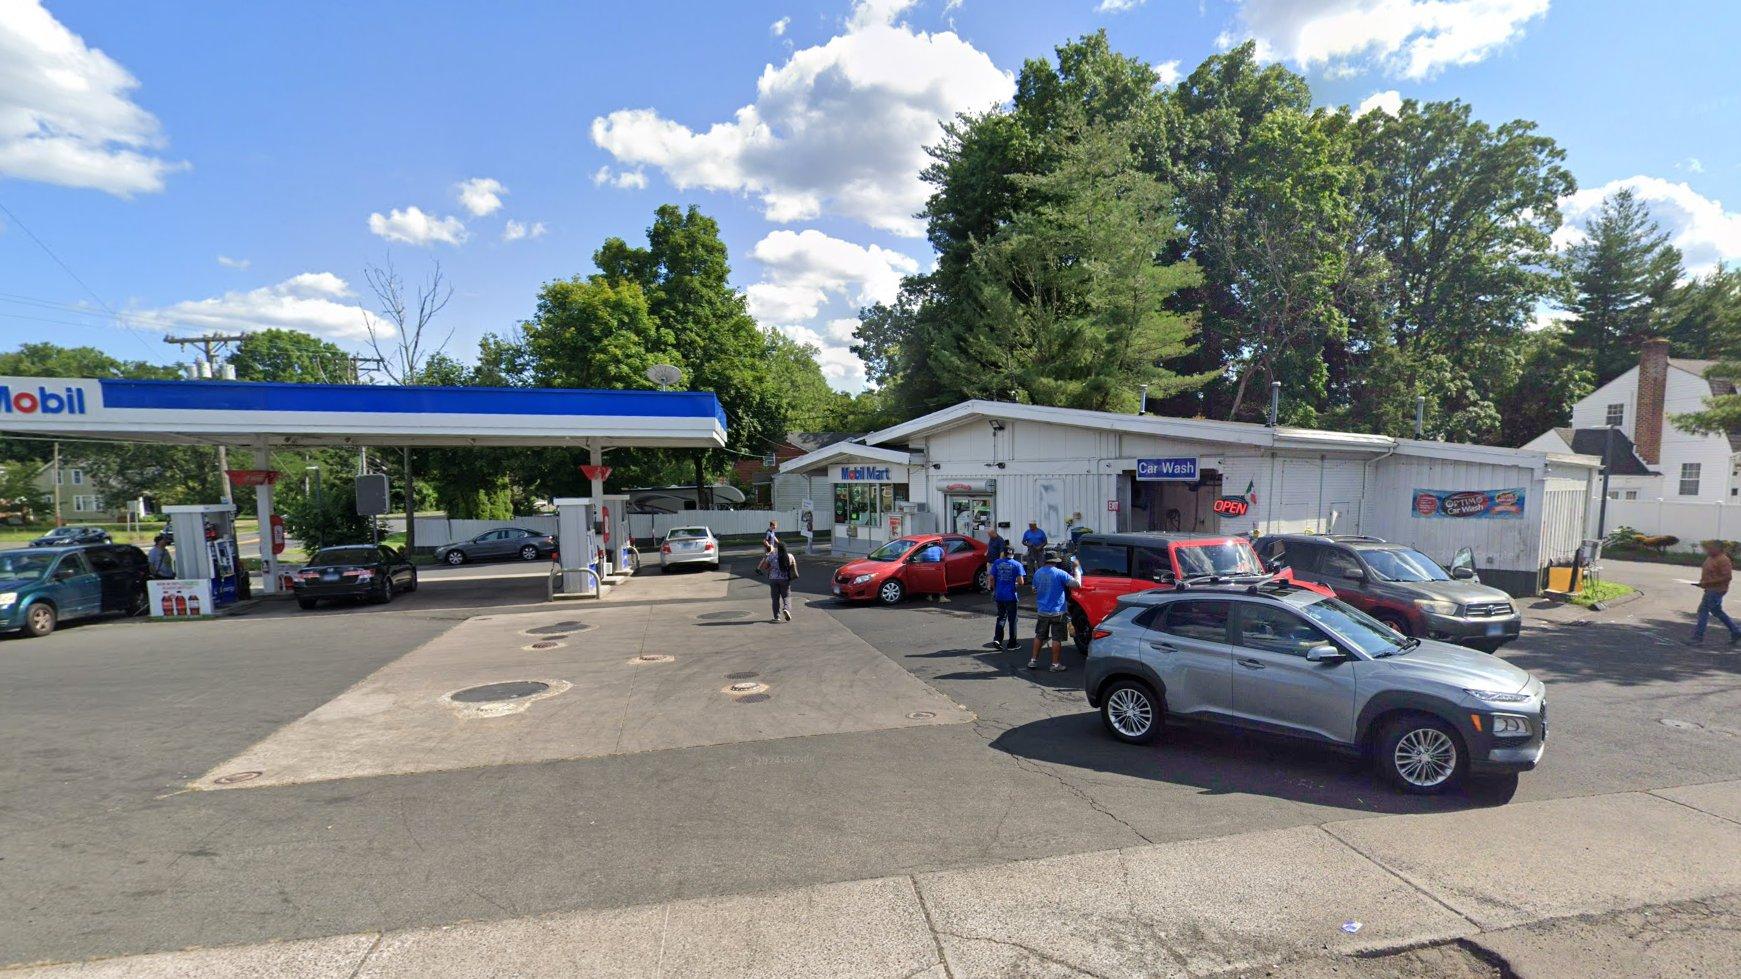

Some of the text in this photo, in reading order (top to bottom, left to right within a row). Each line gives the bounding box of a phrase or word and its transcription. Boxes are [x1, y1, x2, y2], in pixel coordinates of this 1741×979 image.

[841, 466, 890, 480] Mobil Mart
[1139, 461, 1194, 474] Car Wash
[1213, 500, 1247, 515] OPEN
